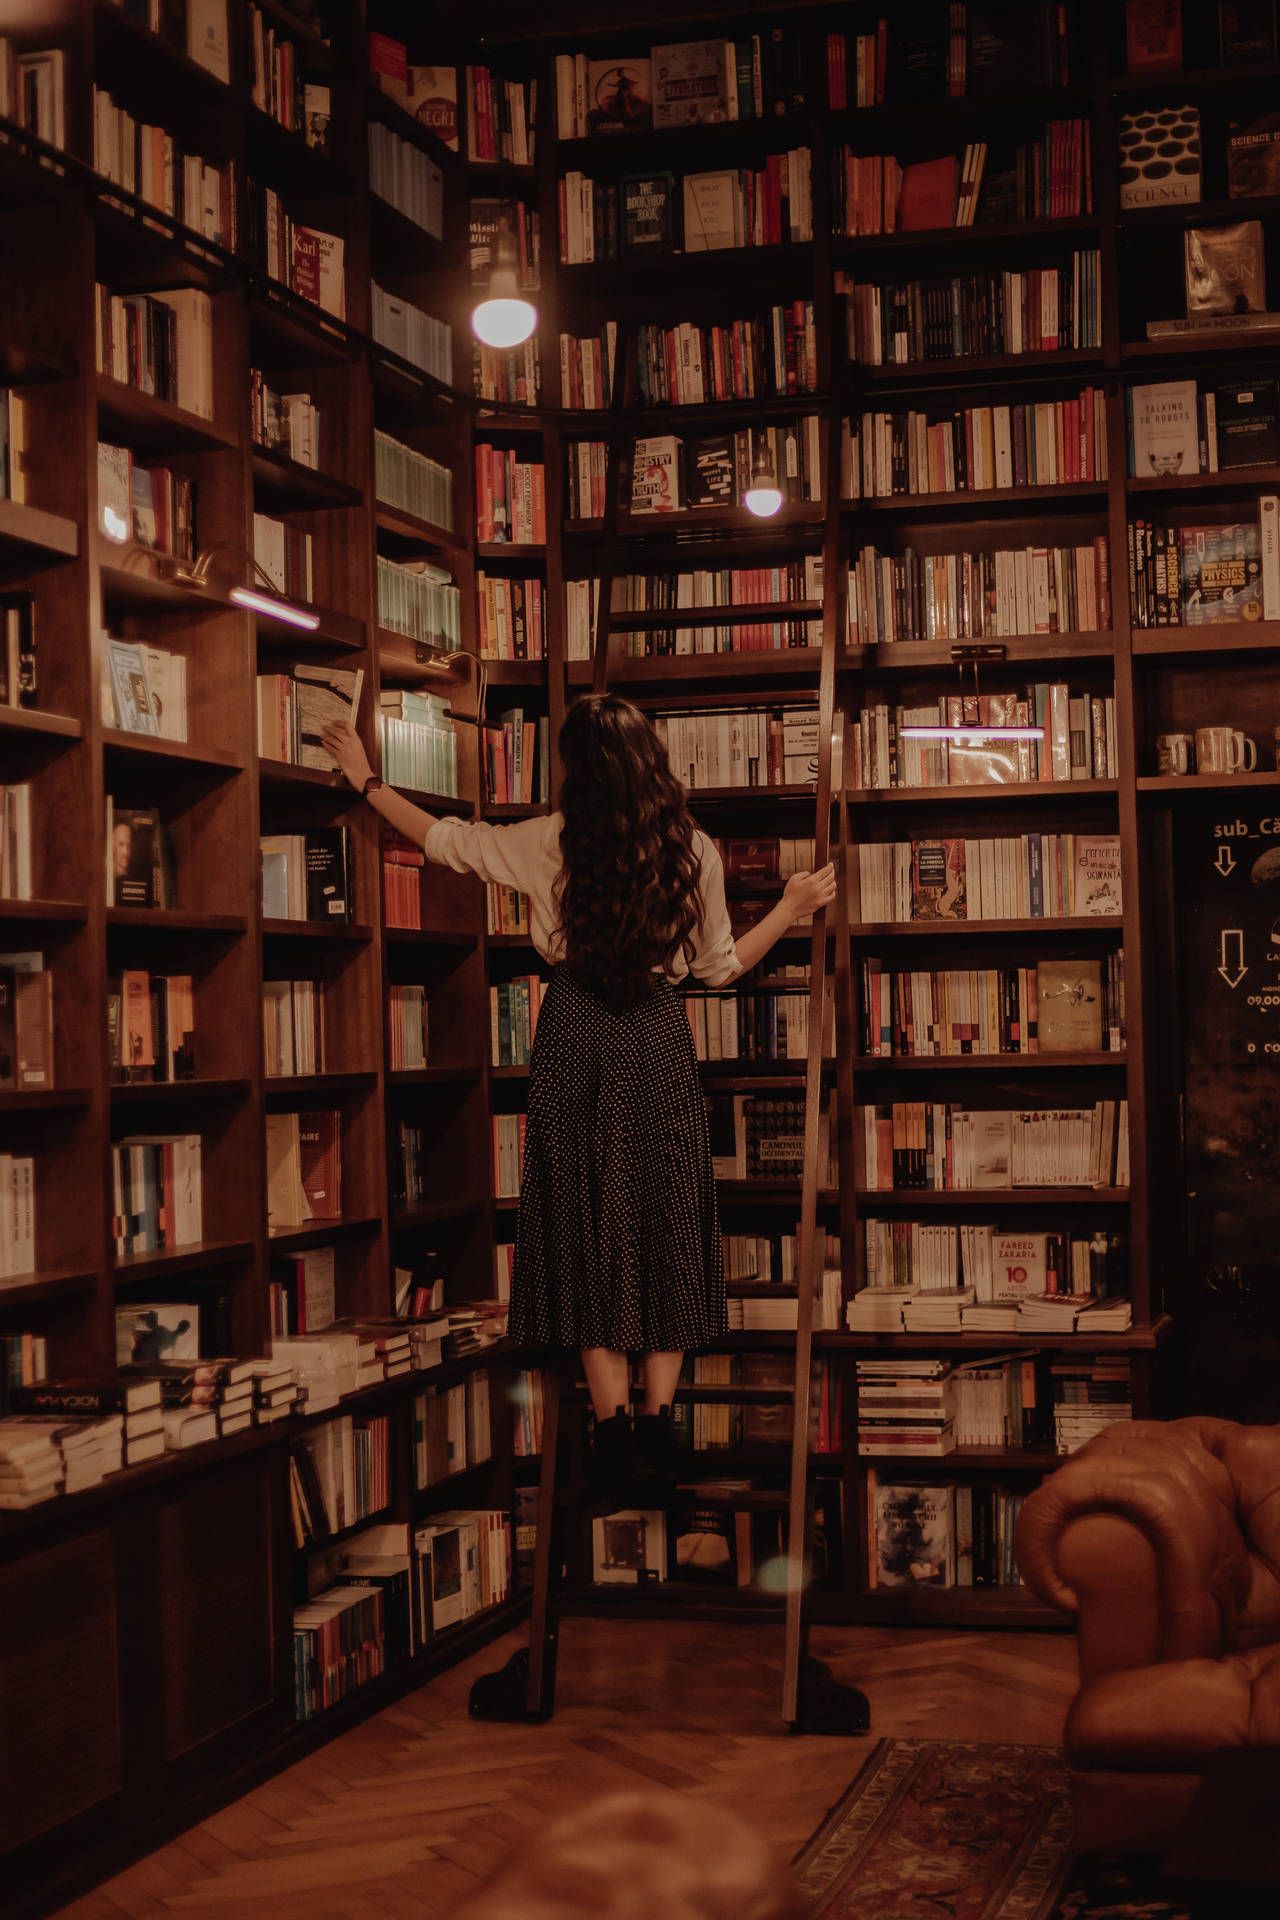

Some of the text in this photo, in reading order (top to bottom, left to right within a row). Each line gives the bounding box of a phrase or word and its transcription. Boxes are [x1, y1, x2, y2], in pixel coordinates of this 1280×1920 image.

[1231, 133, 1270, 146] SCIENCE
[639, 182, 654, 194] THE
[1124, 184, 1190, 204] SCIENCE
[626, 194, 666, 210] BOOKSHOP
[637, 208, 660, 222] BOOK
[296, 236, 316, 257] Karl
[1214, 317, 1250, 330] MOON
[1146, 401, 1184, 414] TALKING
[1140, 412, 1190, 425] TO ROBOTS
[1136, 529, 1145, 571] Reactions
[1201, 567, 1246, 581] PHYSICS
[761, 1141, 803, 1150] CANONUL
[1000, 1241, 1034, 1250] FAREED
[998, 1250, 1037, 1259] ZAKARIA
[1006, 1266, 1027, 1284] 10
